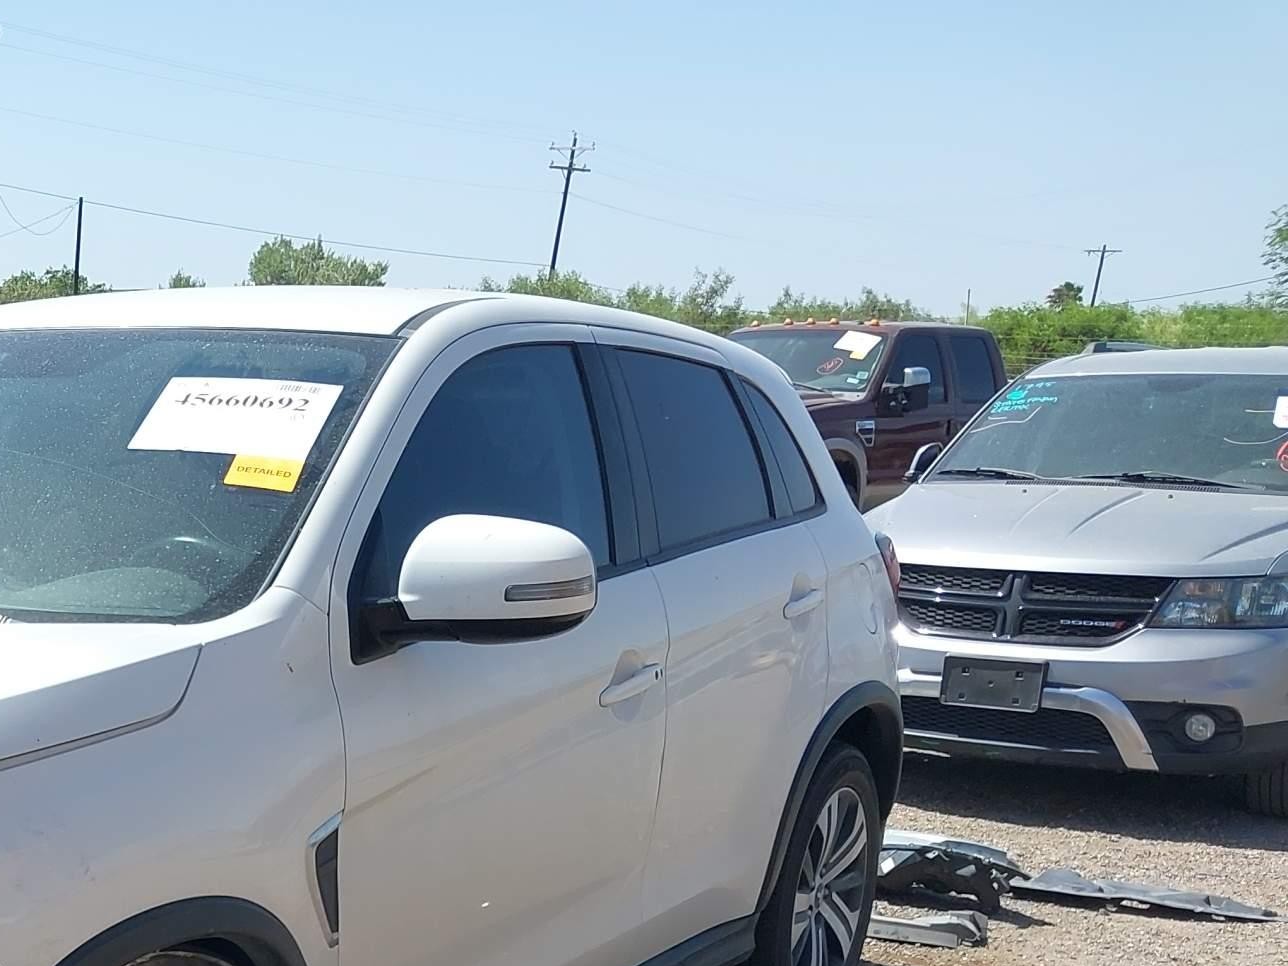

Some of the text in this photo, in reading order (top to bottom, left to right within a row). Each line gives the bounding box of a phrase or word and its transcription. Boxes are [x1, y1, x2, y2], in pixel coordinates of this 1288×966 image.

[174, 392, 310, 412] 45660692
[236, 465, 292, 478] DETAILED
[1059, 619, 1114, 627] DODGE
